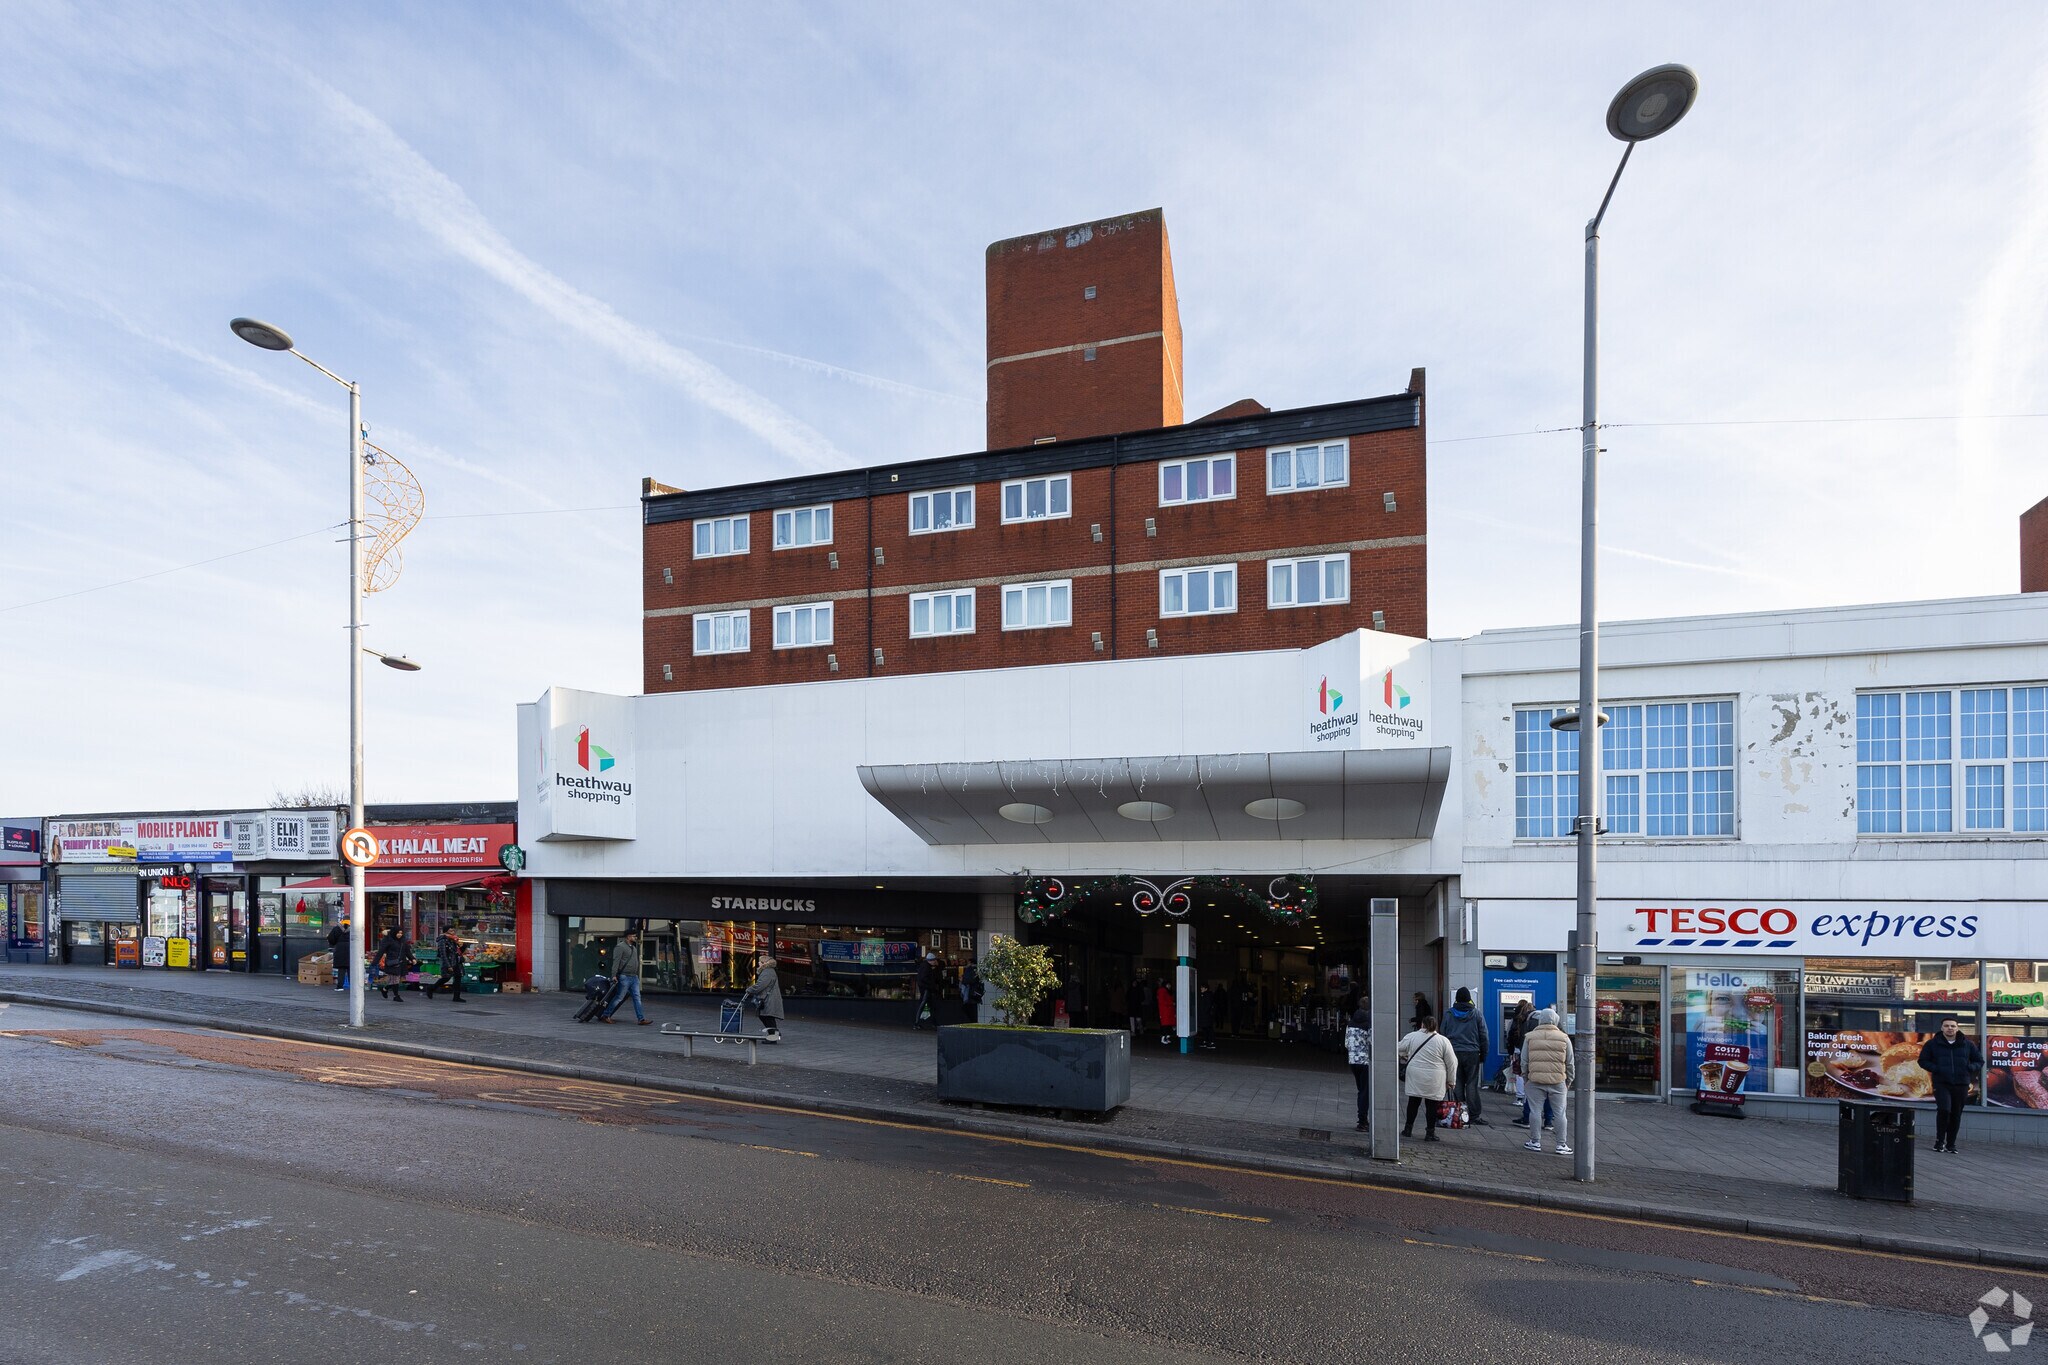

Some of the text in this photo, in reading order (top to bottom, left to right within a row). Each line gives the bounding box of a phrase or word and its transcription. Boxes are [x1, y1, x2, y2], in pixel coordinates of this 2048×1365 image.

[1310, 712, 1358, 734] heathway
[1368, 710, 1423, 731] heathway
[1317, 727, 1351, 742] shopping
[1376, 725, 1415, 740] shopping
[556, 773, 631, 796] heathway
[568, 789, 621, 805] shopping
[137, 821, 218, 838] MOBILE PLANET
[277, 822, 298, 836] ELM
[92, 839, 101, 849] DE
[277, 837, 298, 847] CARS
[391, 838, 443, 855] HALAL
[444, 837, 489, 854] MEAT
[147, 867, 169, 876] UNION
[711, 896, 816, 912] STARBUCKS
[1635, 908, 1798, 935] TESCO
[1811, 910, 1978, 947] express
[1808, 1032, 1863, 1042] Baking fresh
[1991, 1040, 2004, 1048] All
[1714, 1046, 1741, 1054] COSTA
[1807, 1041, 1830, 1049] from
[2011, 1050, 2021, 1058] 21
[2023, 1050, 2042, 1060] day
[1726, 1073, 1736, 1089] COSTA
